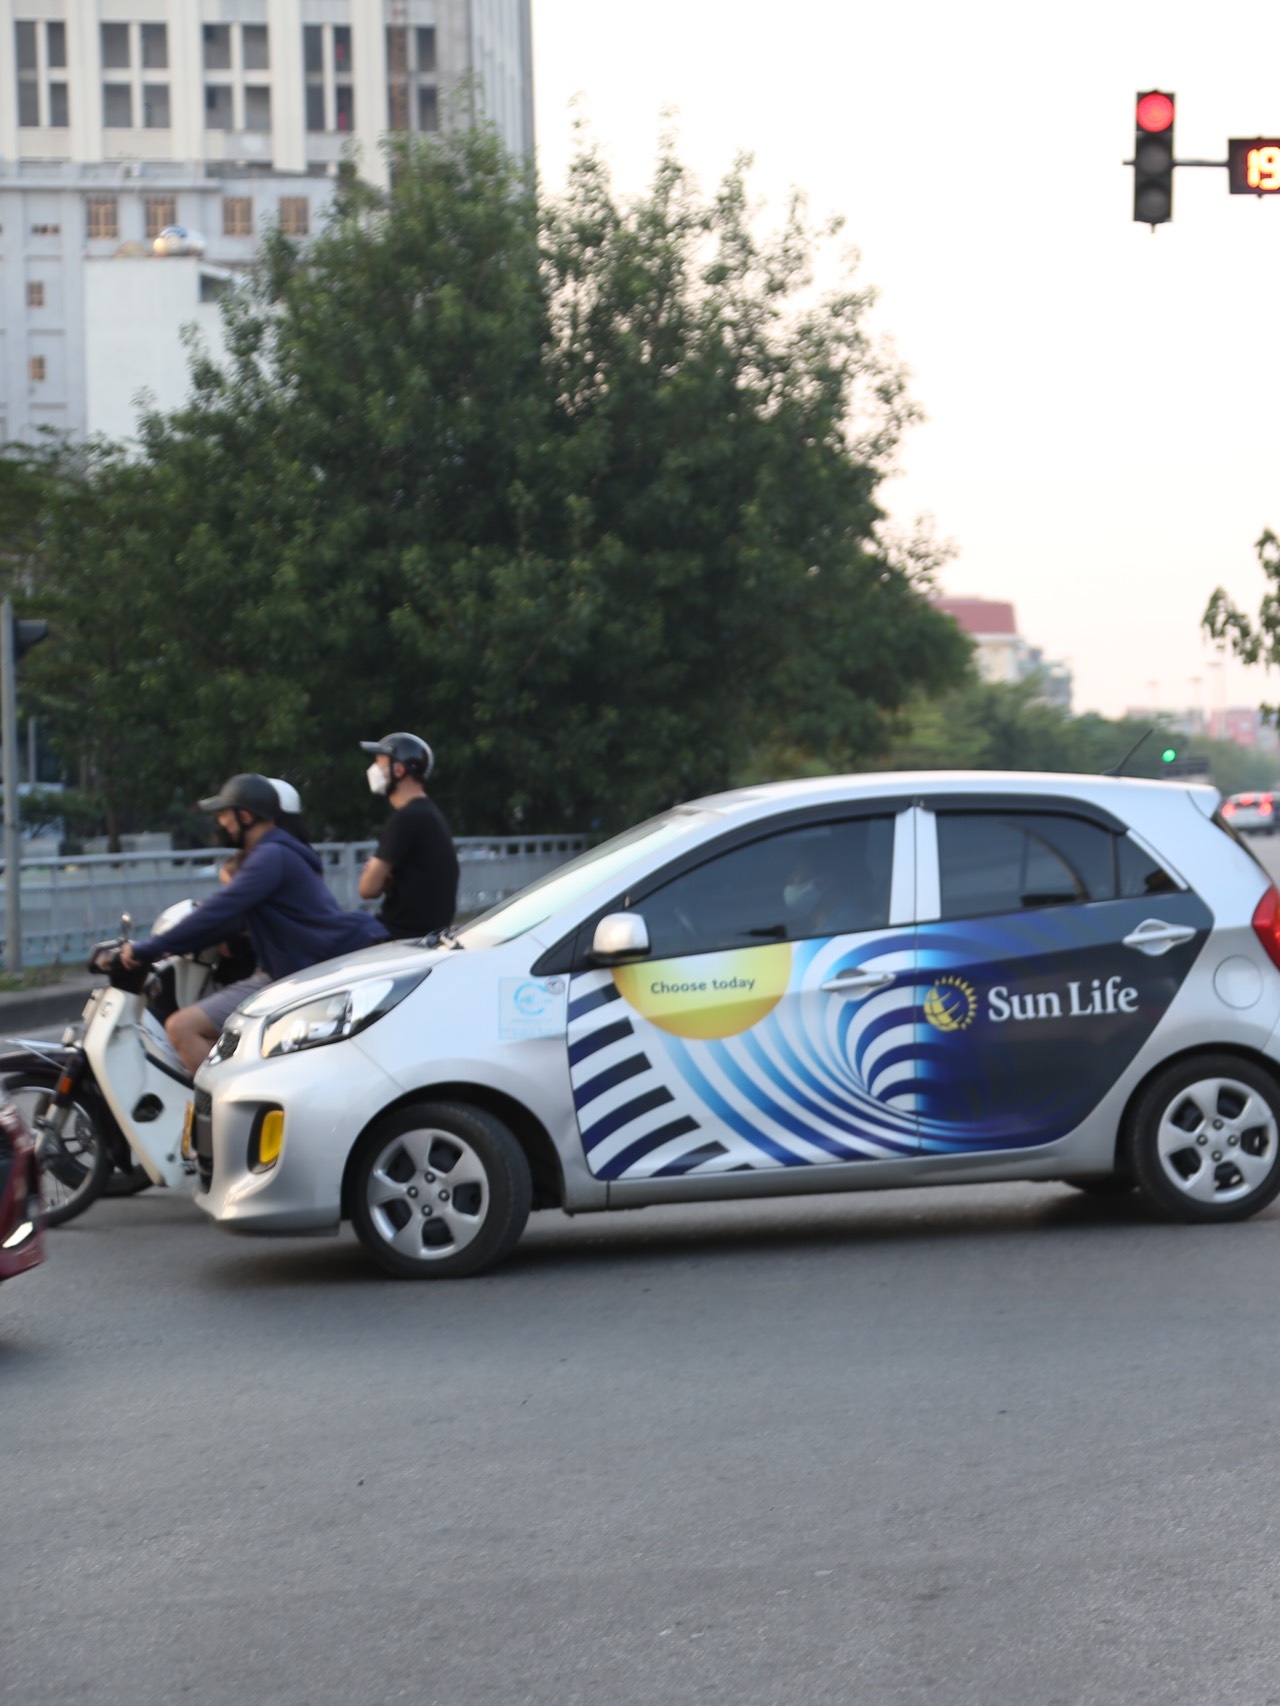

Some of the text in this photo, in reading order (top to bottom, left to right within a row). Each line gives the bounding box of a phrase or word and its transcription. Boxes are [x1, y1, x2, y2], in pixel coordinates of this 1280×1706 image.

[650, 976, 755, 994] Choose today
[988, 975, 1139, 1022] Sun Life
